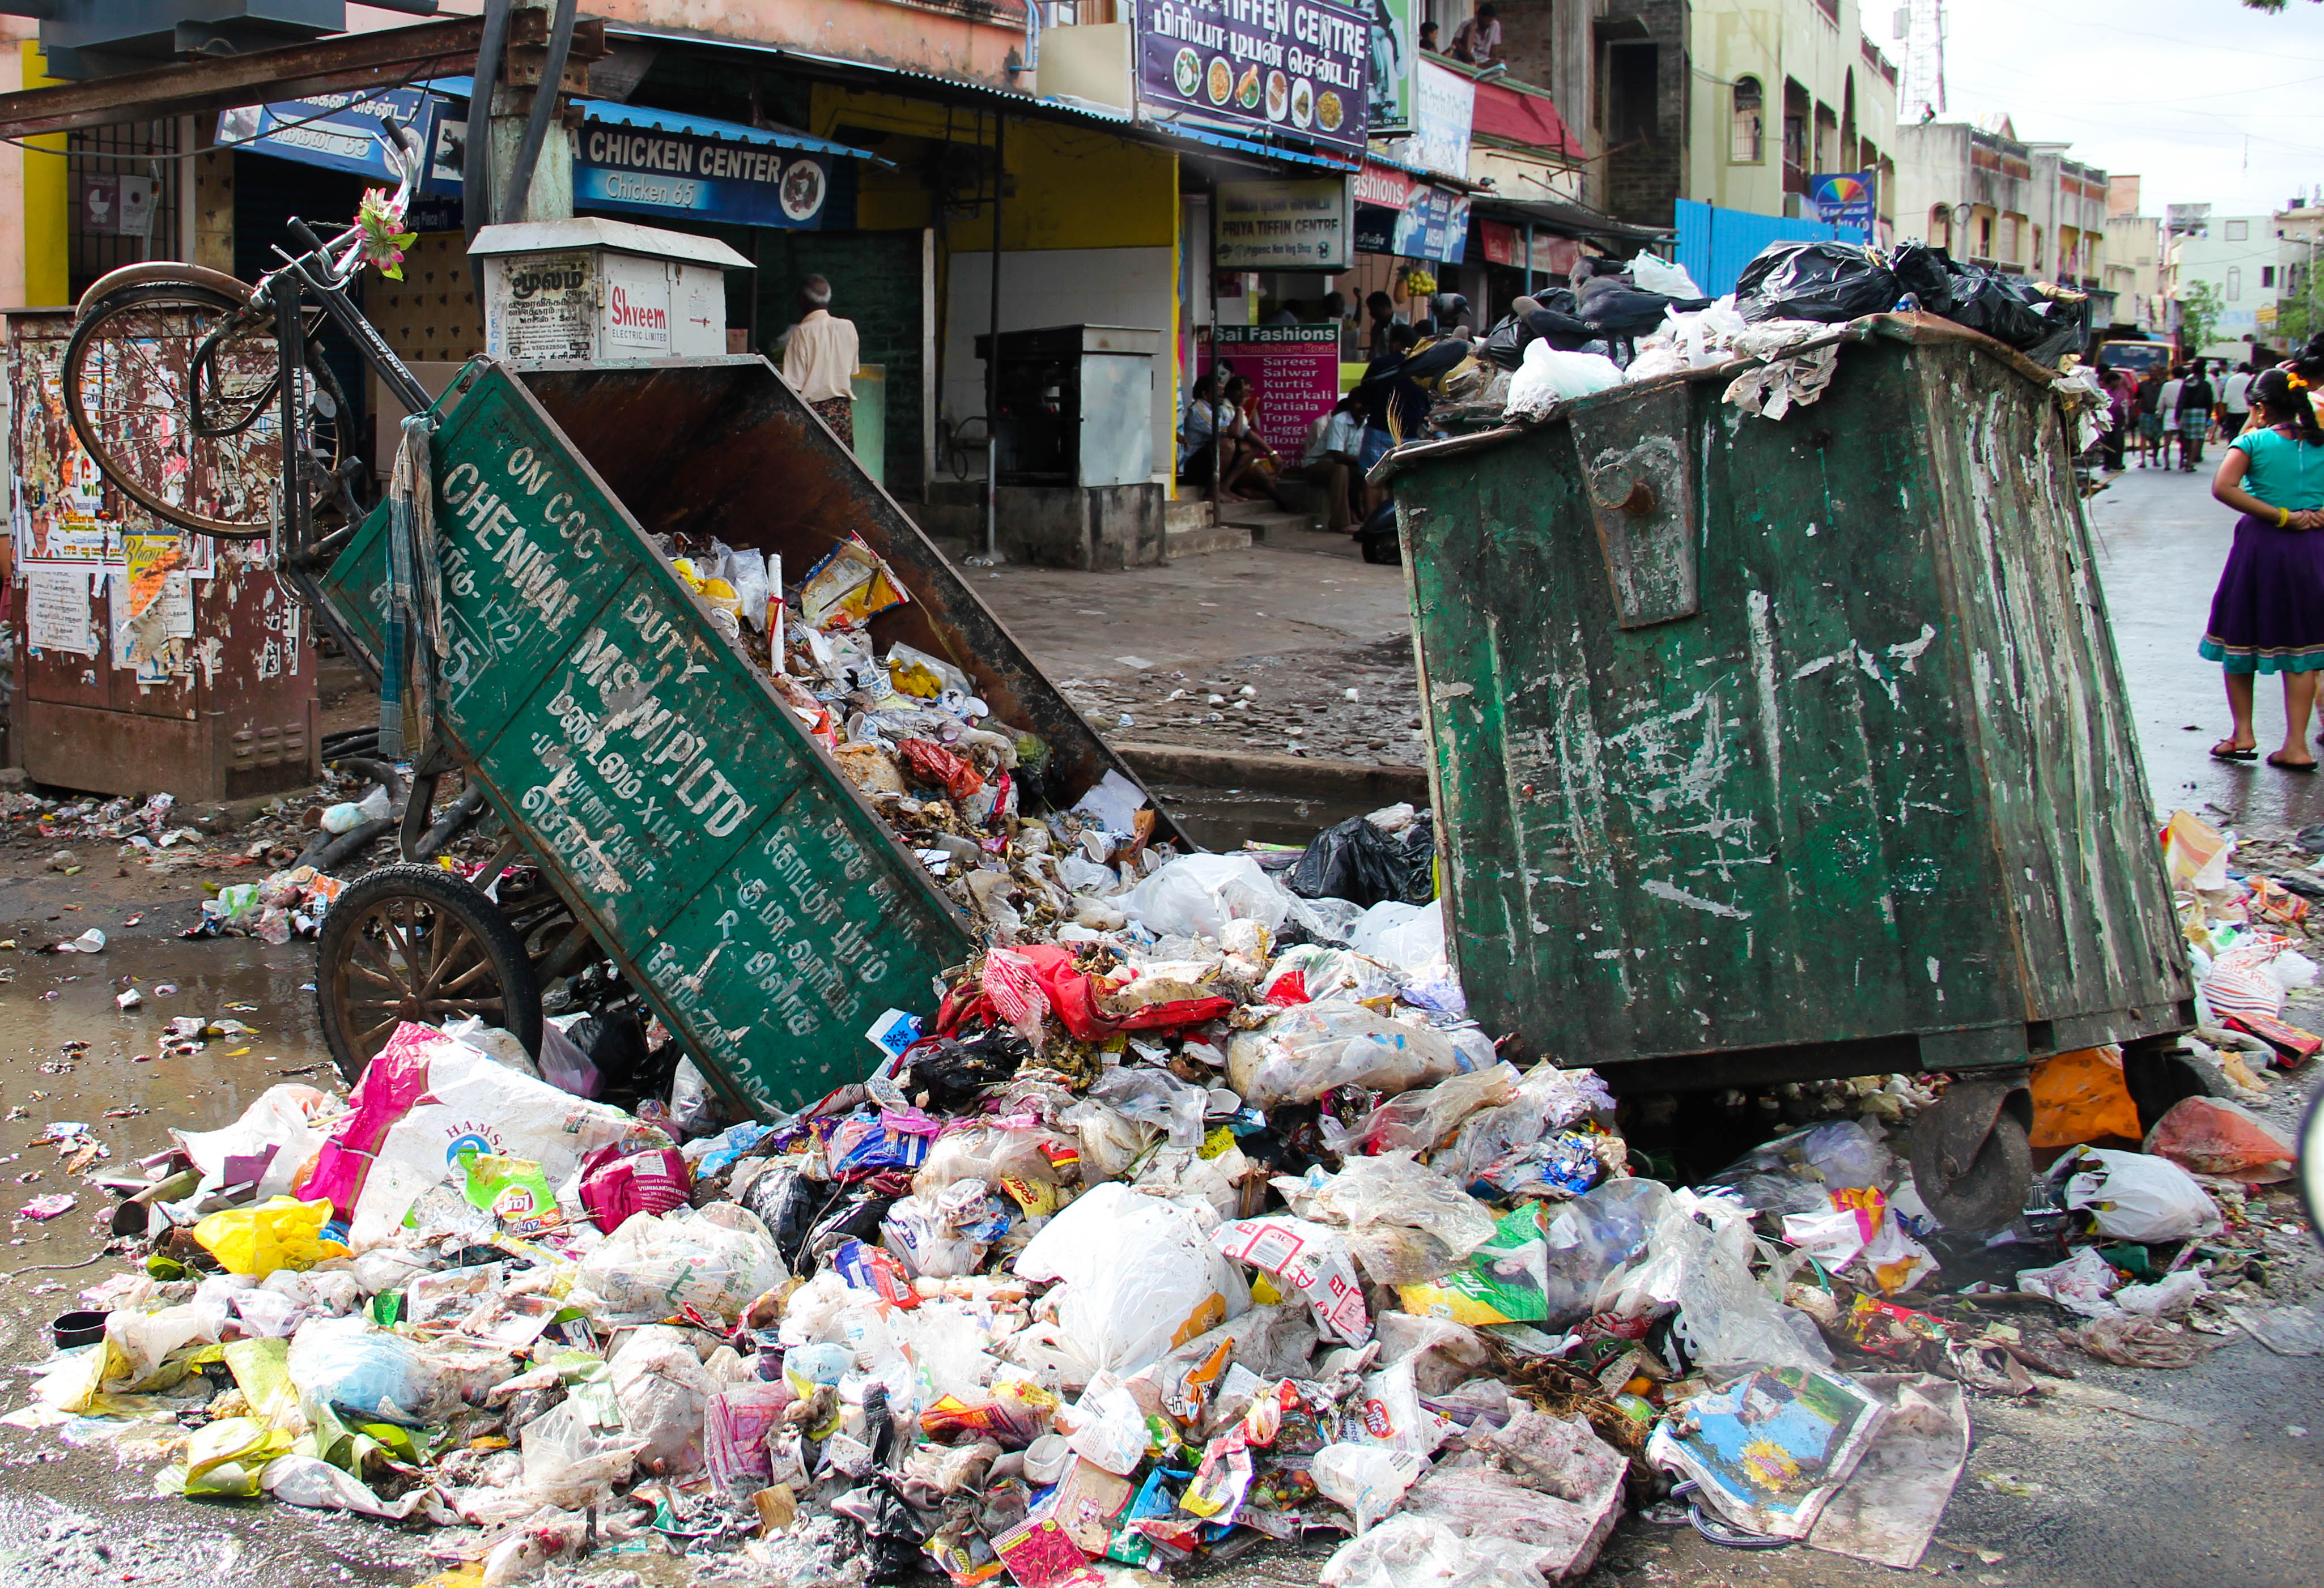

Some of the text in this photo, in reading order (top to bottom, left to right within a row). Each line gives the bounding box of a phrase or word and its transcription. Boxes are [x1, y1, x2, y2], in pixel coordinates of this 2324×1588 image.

[1294, 5, 1366, 59] CENTRE
[590, 131, 692, 172] CHICKEN
[699, 145, 781, 183] CENTER
[606, 173, 694, 205] Chicken 65
[1353, 172, 1404, 205] ashions
[611, 286, 666, 329] Shreem
[612, 329, 667, 342] ELECTRIC LIMITED
[1249, 327, 1336, 341] Fashions
[358, 320, 409, 381] Heavy Duty
[1263, 357, 1316, 366] Sarees
[1263, 368, 1319, 377] Salwar
[1263, 380, 1313, 388] Kurtis
[292, 368, 305, 429] NEELAM
[1263, 390, 1332, 399] Anarkali
[1263, 402, 1319, 411] Patiala
[1263, 413, 1301, 423] Tops
[1263, 424, 1308, 435] Leggi
[1263, 436, 1306, 444] Blous
[443, 463, 580, 631] CHENNAI
[508, 447, 708, 683] ON COC DUTY
[445, 1120, 508, 1156] HAMSA
